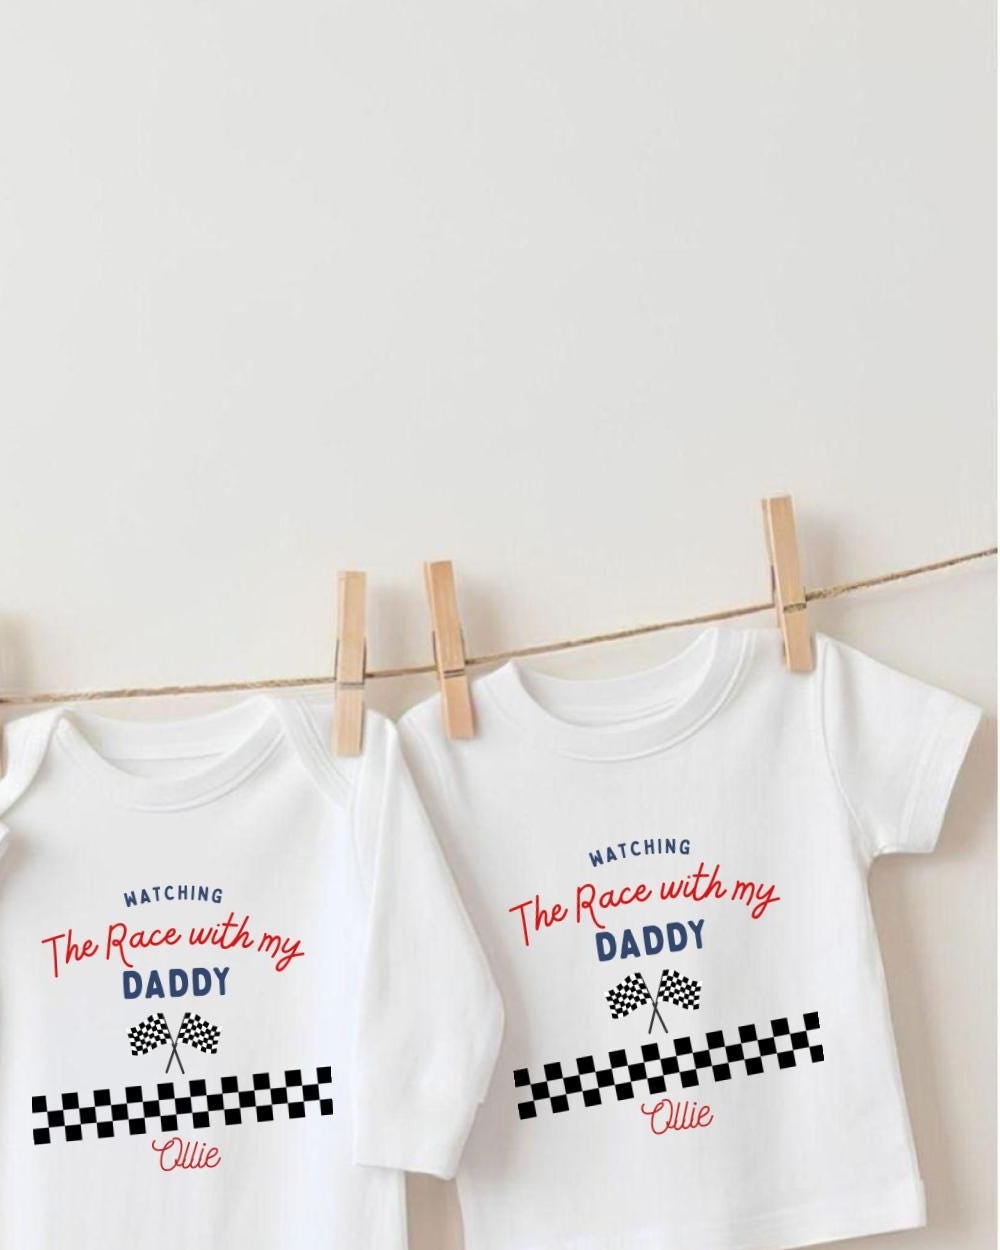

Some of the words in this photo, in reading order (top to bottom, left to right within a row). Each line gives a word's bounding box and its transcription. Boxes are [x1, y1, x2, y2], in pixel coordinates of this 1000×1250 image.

[588, 838, 691, 867] WATCHING
[123, 884, 224, 907] WATCHING
[508, 895, 569, 946] The
[575, 882, 653, 930] Race
[659, 862, 728, 903] with
[730, 880, 781, 921] my
[41, 933, 100, 977] The
[105, 922, 183, 969] Race
[188, 911, 255, 951] with
[257, 932, 305, 973] my
[594, 919, 706, 962] DADDY
[122, 967, 230, 1000] DADDY
[641, 1098, 715, 1136] Ollie
[151, 1137, 221, 1172] Ollie
